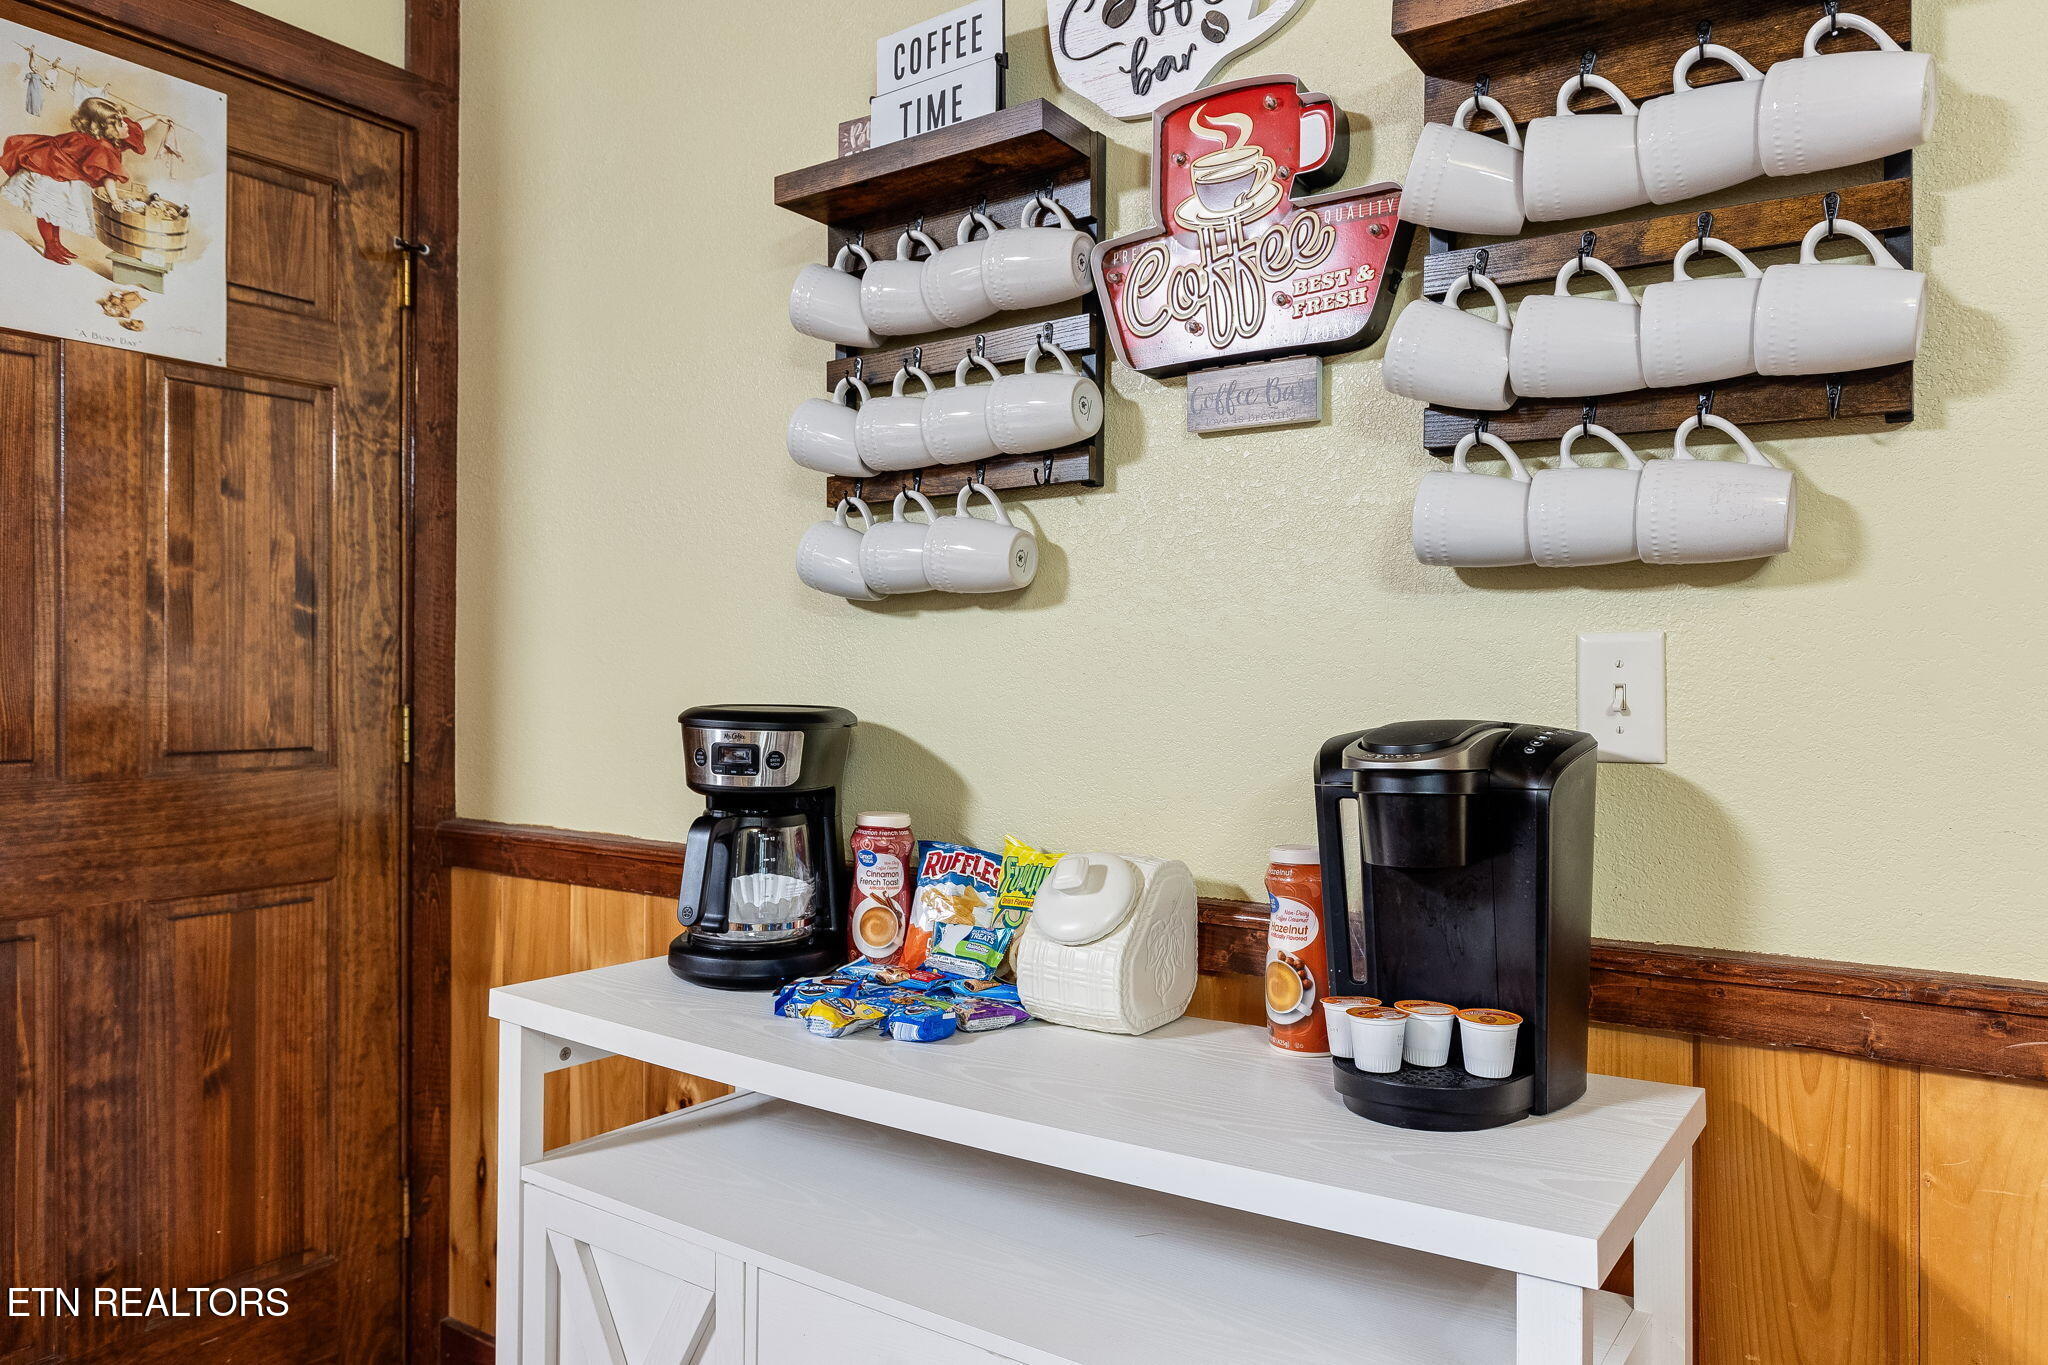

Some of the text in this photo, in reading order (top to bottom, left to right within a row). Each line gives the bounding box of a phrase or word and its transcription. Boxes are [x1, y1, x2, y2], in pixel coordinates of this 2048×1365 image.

[894, 13, 983, 81] COFFEE
[1119, 36, 1197, 96] bar
[899, 84, 963, 138] TIME
[1324, 197, 1395, 225] QUALITY
[1112, 239, 1179, 266] PREM
[1122, 211, 1337, 348] Coffee
[1292, 264, 1376, 298] BEST &
[1291, 286, 1369, 320] FRESH
[1190, 380, 1258, 416] Coffee
[1248, 409, 1297, 423] brewing
[859, 877, 899, 886] French Toast
[865, 869, 900, 878] Cinnamon
[921, 850, 1001, 889] RUFFLES
[971, 932, 995, 945] TREATS
[1271, 922, 1309, 935] Hazelnut
